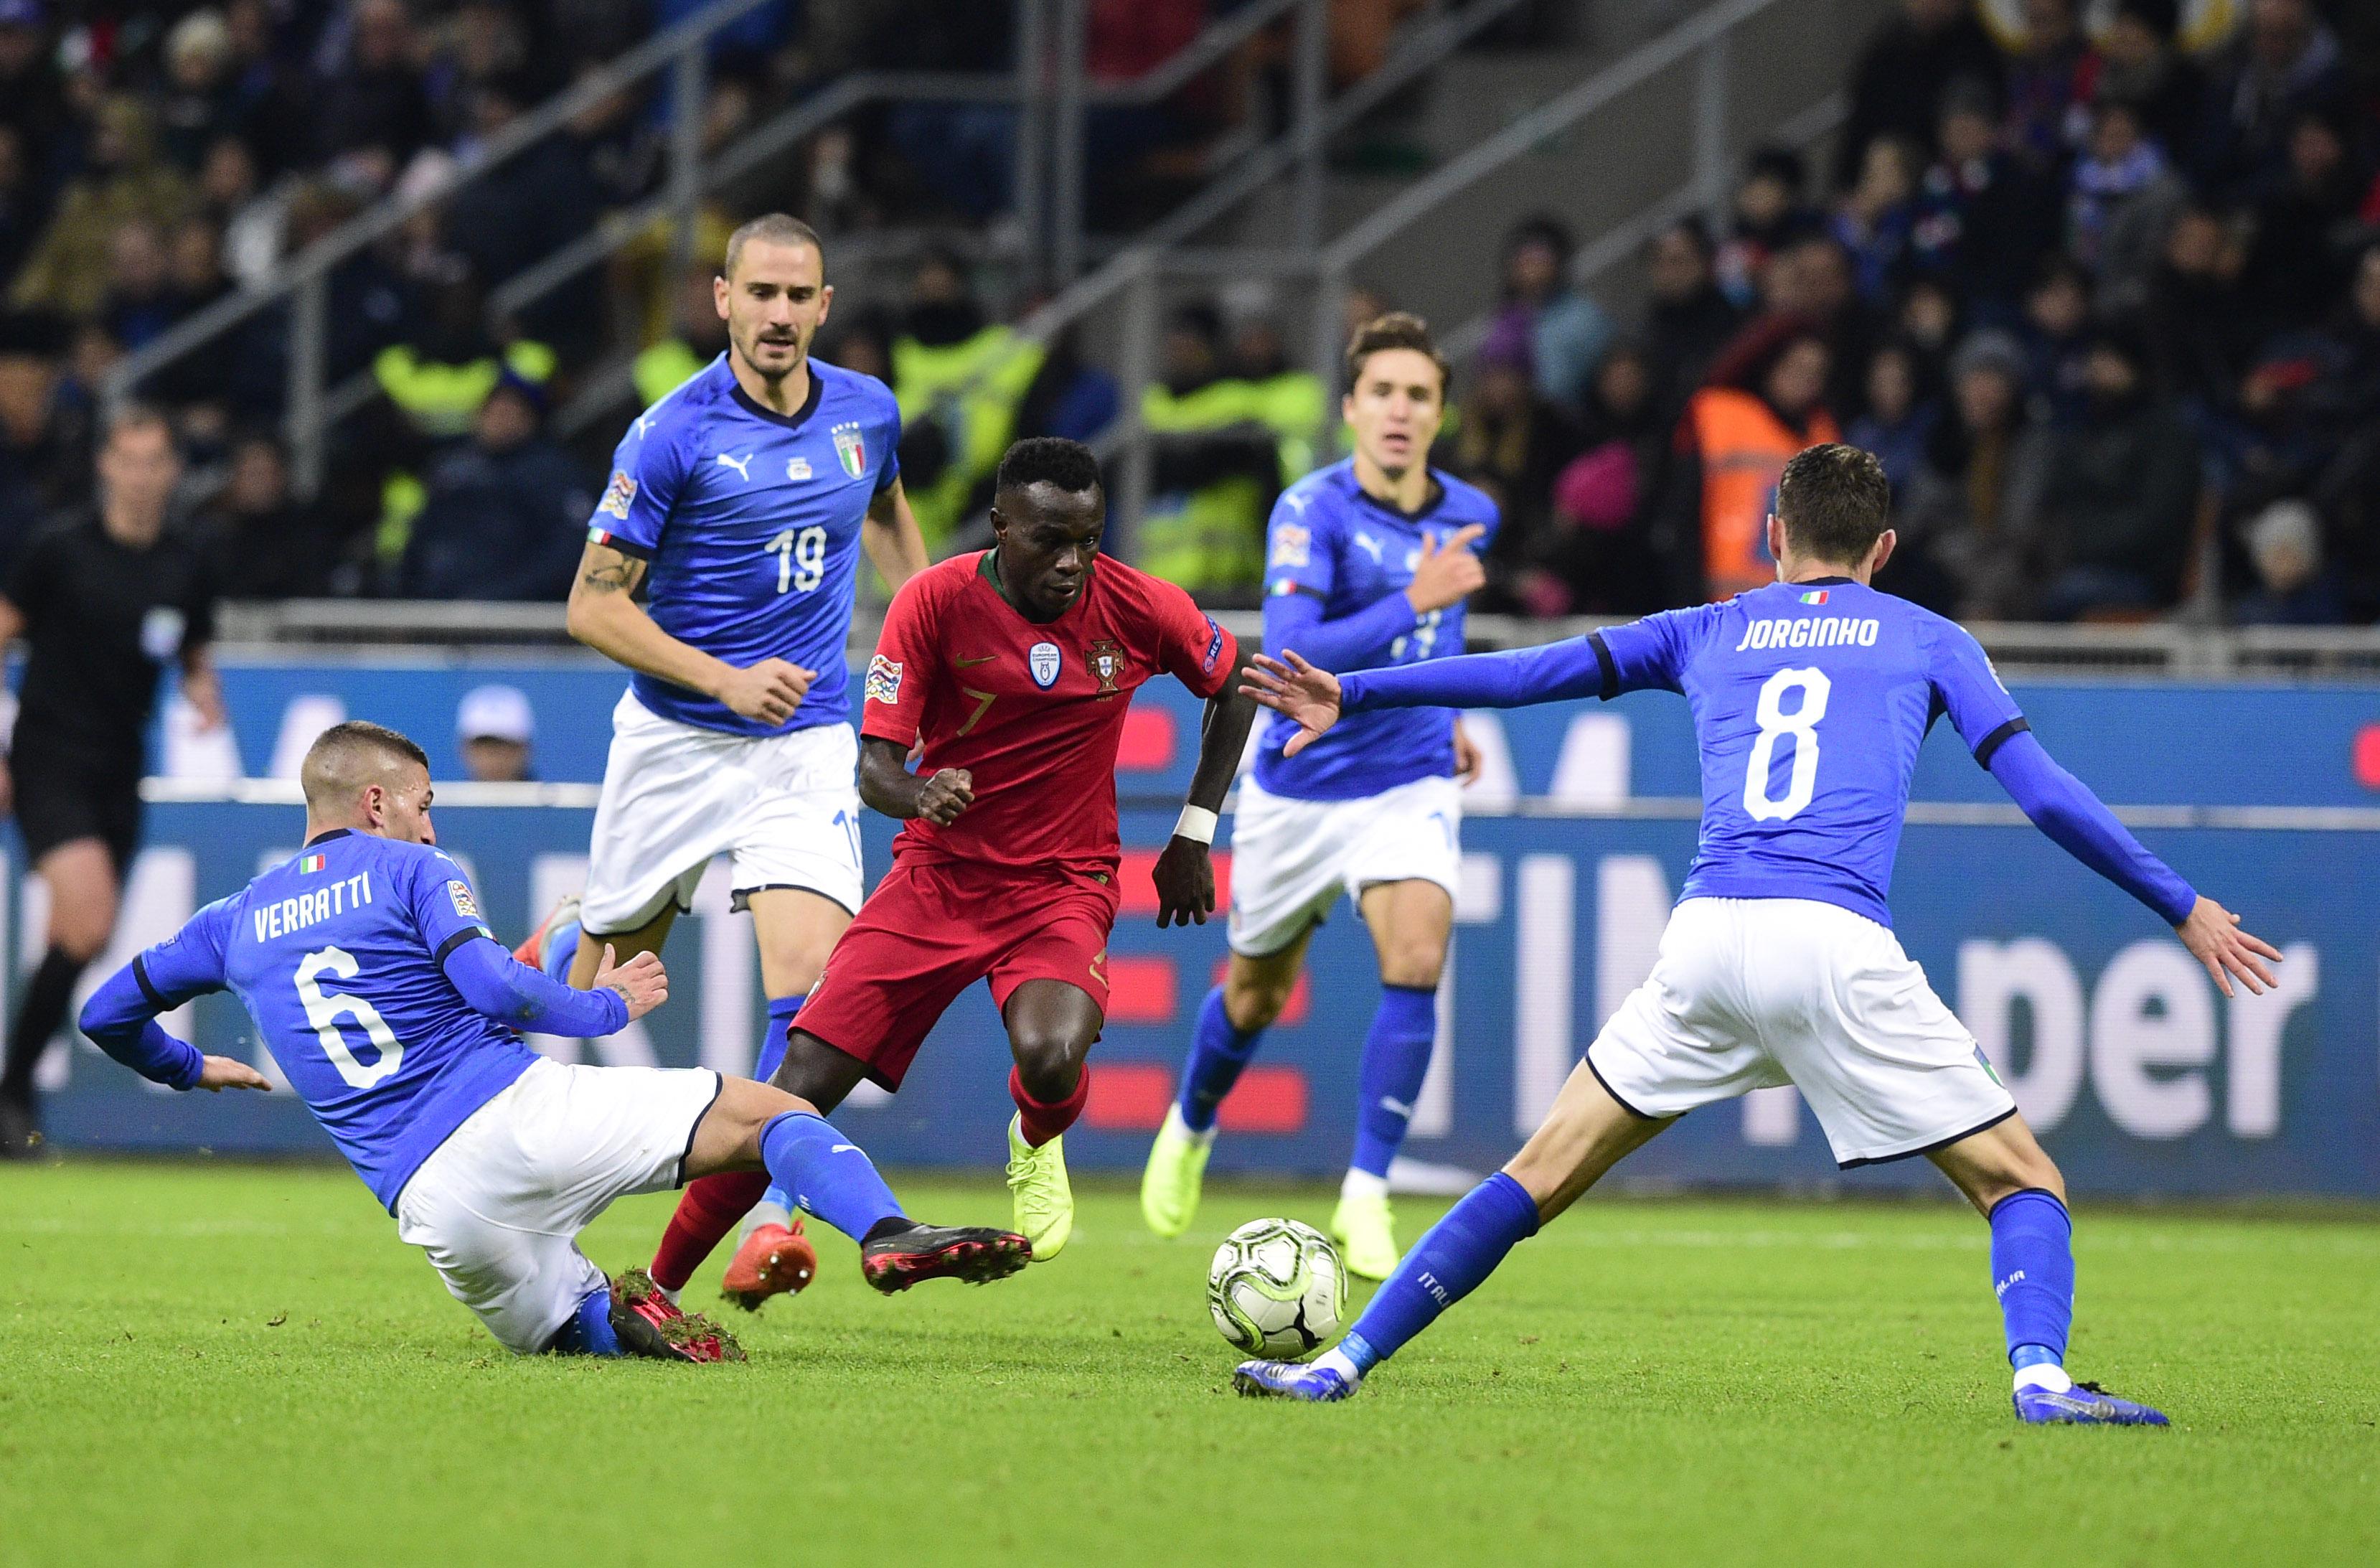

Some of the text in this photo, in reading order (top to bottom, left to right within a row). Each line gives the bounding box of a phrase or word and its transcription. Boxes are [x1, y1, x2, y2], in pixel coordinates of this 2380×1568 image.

[766, 527, 827, 593] 19
[1735, 617, 1879, 652] JORGINHO
[956, 687, 998, 738] 7
[1743, 667, 1832, 822] 8
[253, 870, 373, 945] VERRATTI
[293, 945, 405, 1089] 6
[1955, 936, 2320, 1141] per
